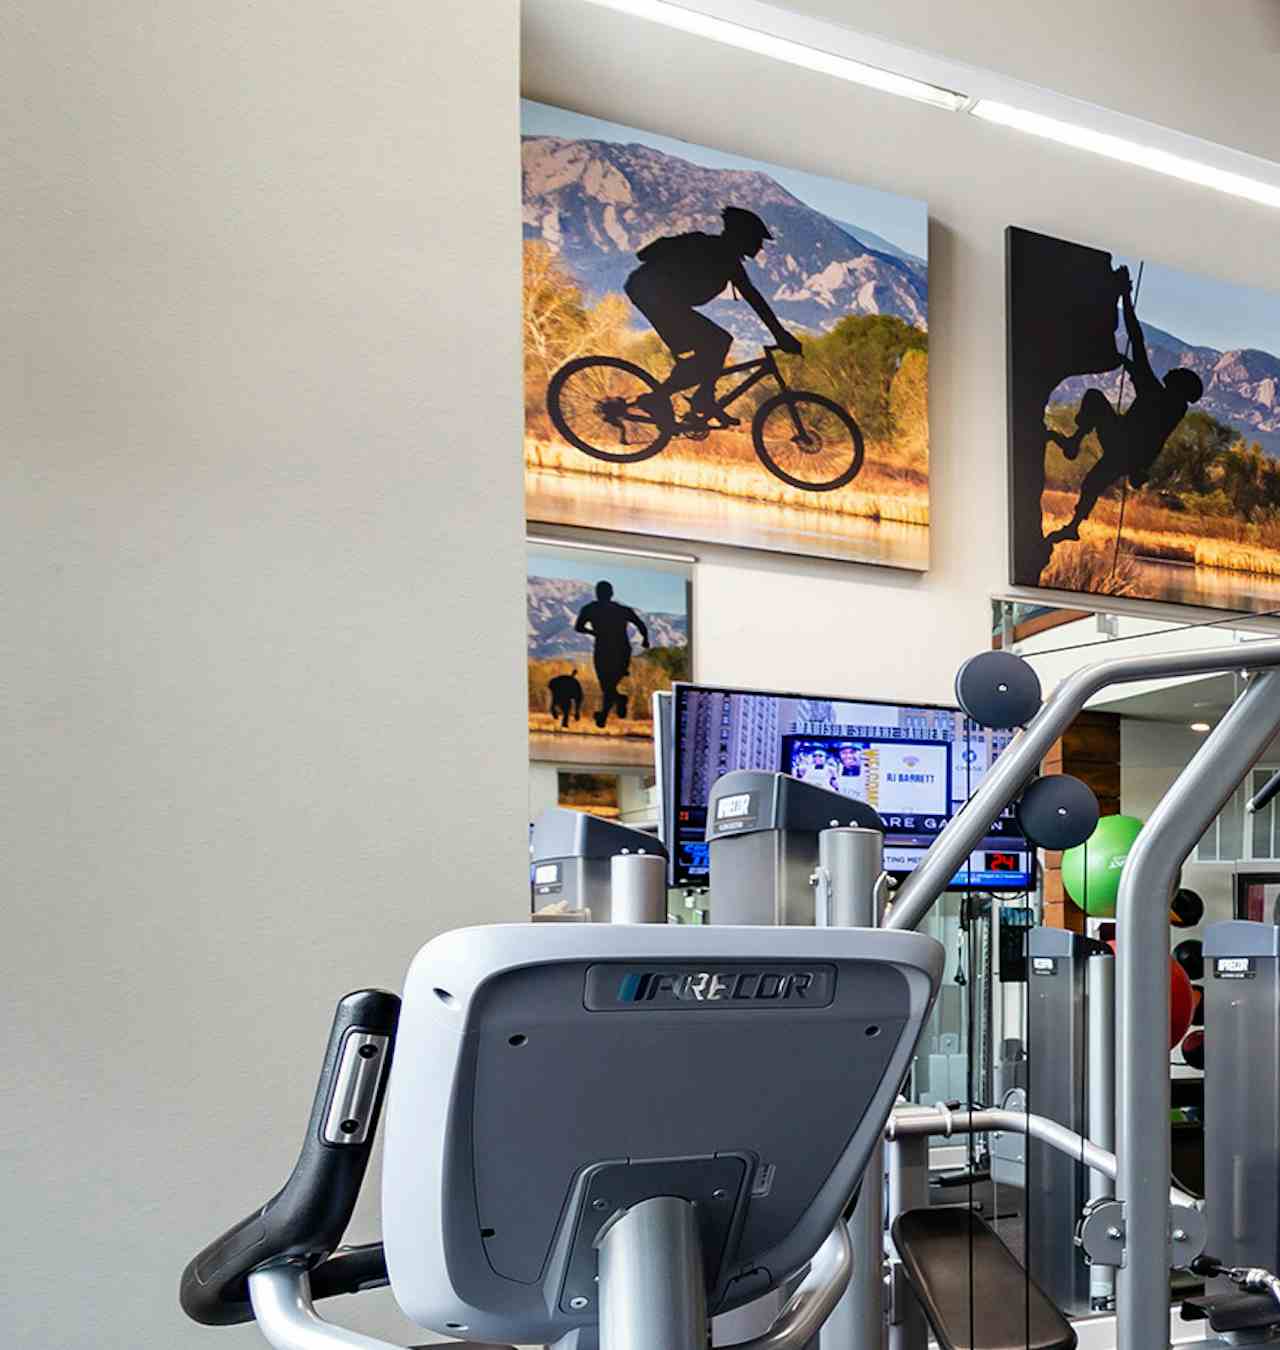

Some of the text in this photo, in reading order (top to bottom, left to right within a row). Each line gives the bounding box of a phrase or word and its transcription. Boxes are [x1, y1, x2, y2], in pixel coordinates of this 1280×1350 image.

[898, 773, 934, 784] BARRETT
[990, 851, 1015, 873] 24
[645, 971, 816, 1001] PRECOR
